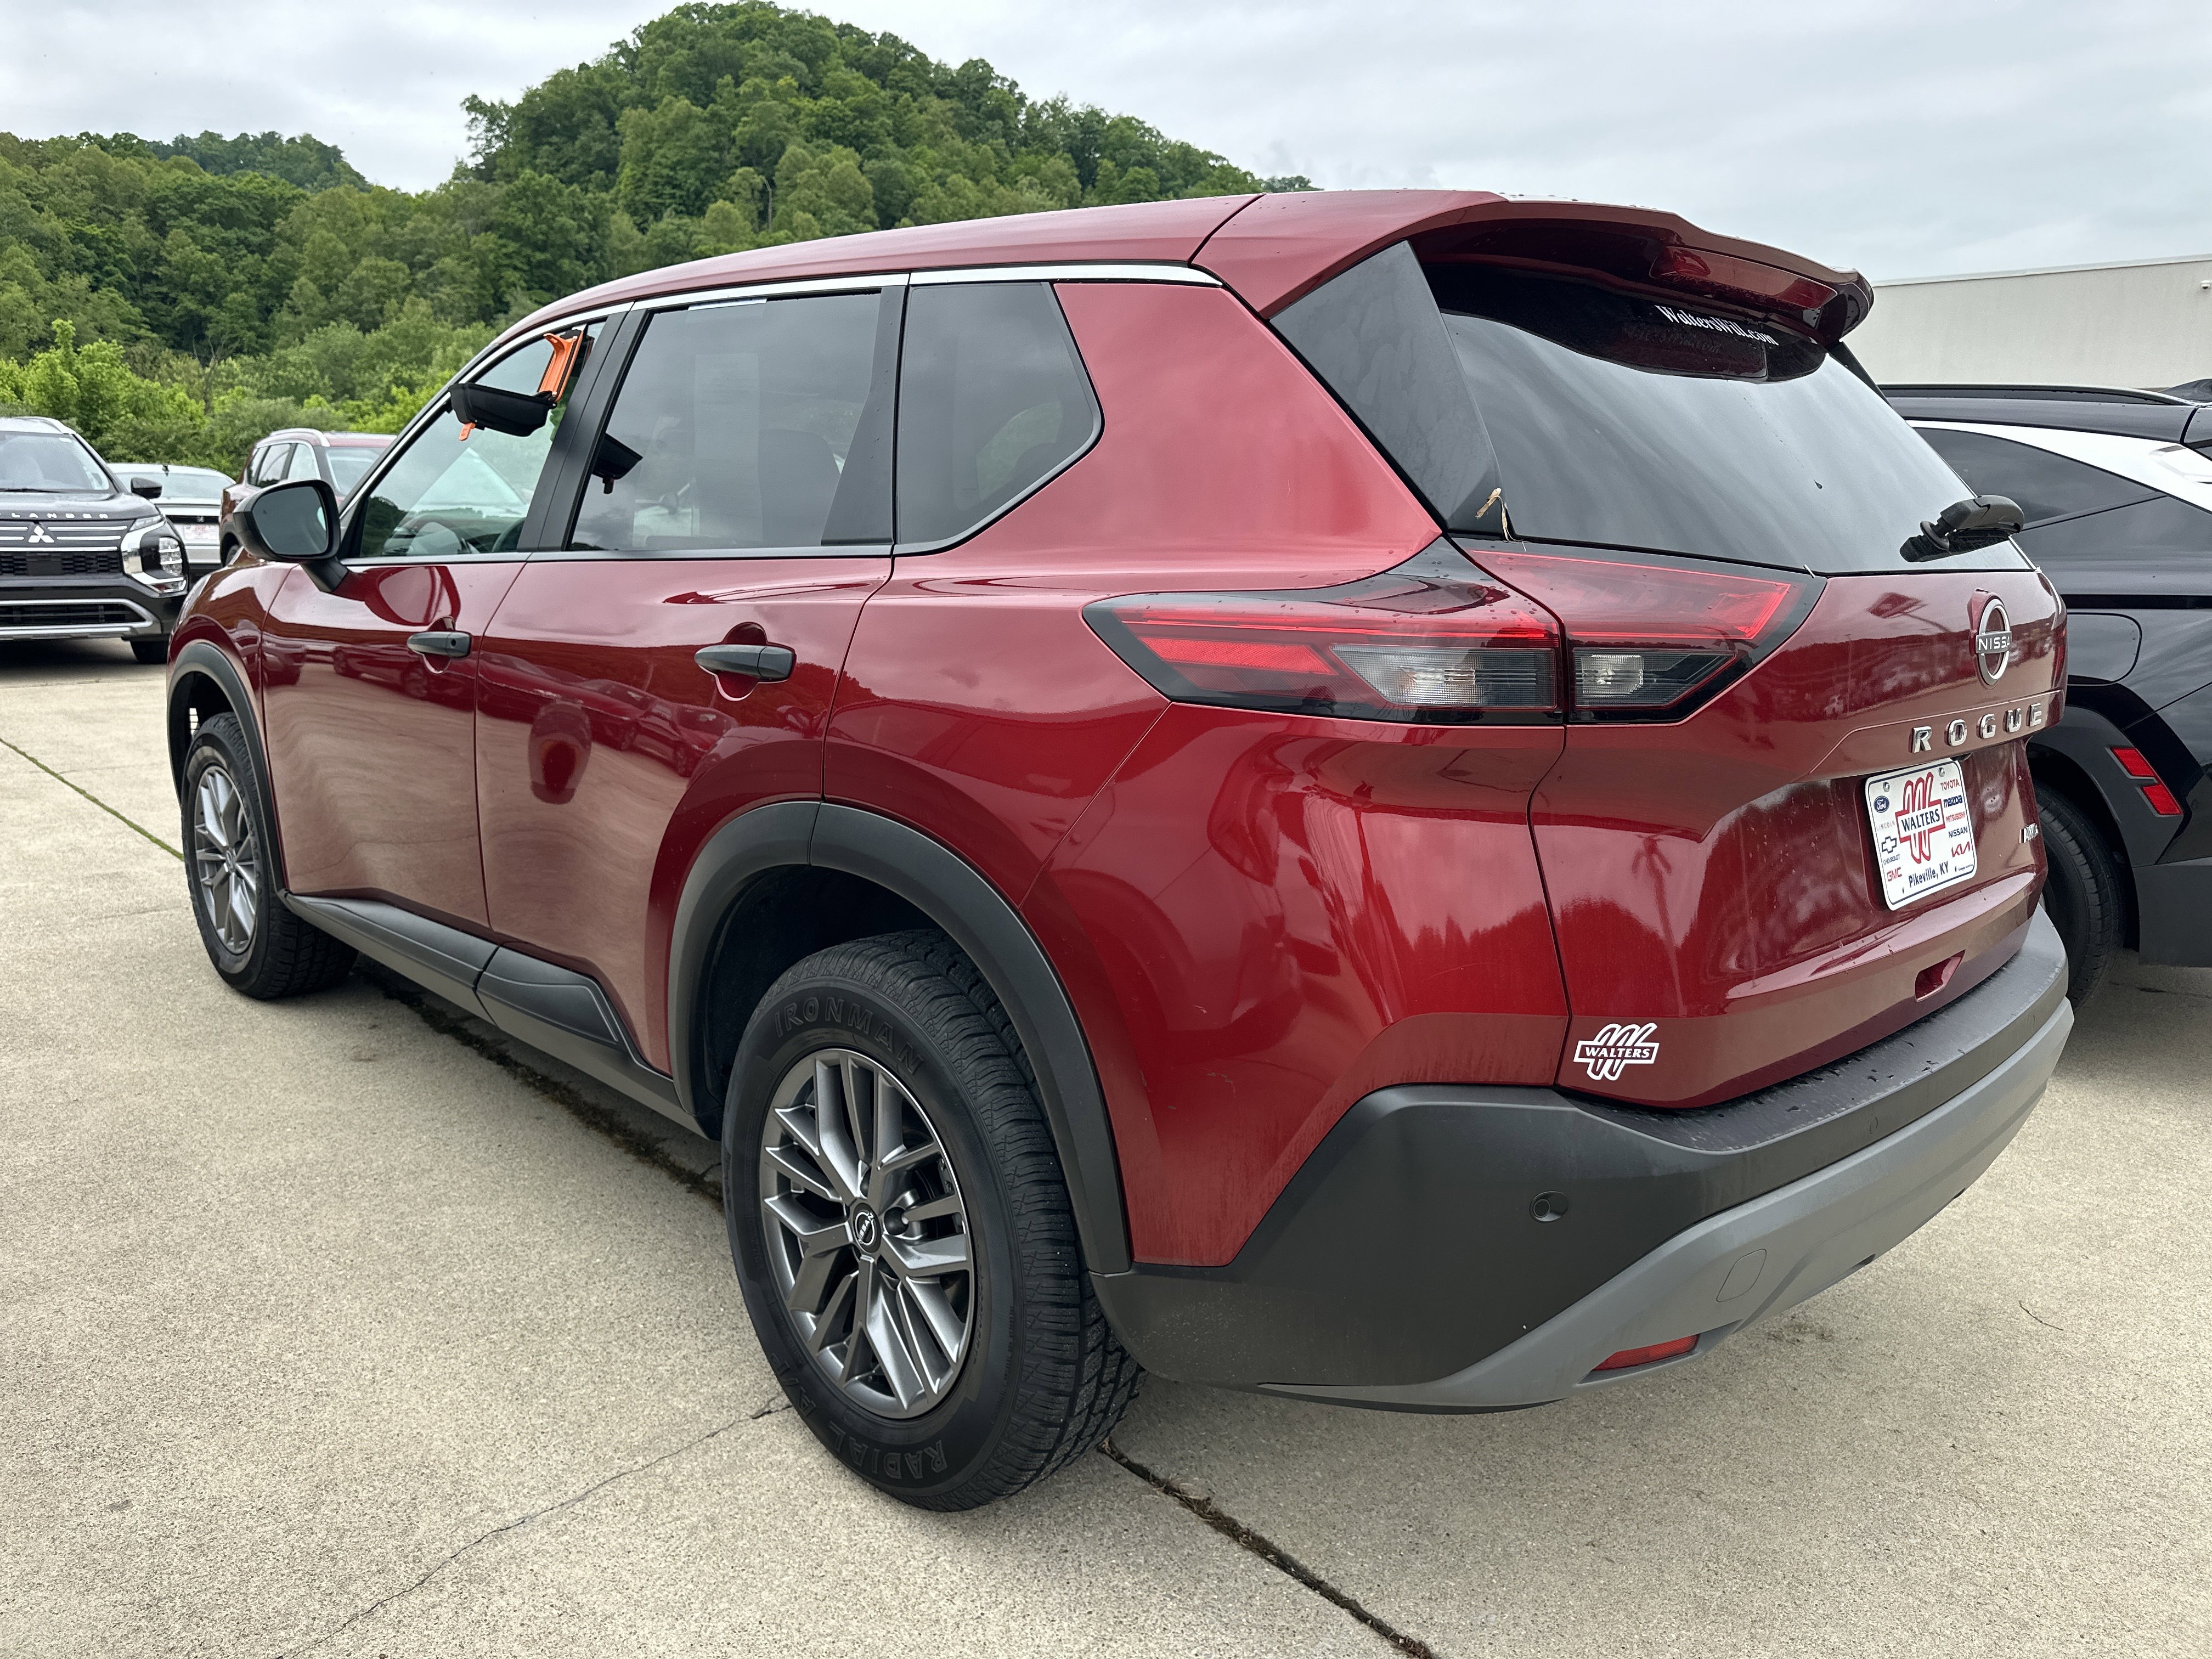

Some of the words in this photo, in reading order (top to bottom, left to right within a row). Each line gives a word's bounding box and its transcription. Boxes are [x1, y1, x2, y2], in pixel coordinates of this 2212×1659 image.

[1655, 305, 1779, 346] WaltersWill.com
[1978, 636, 2011, 651] NISSA
[1911, 703, 2042, 753] ROGUE
[1940, 778, 1960, 791] TOYOTA
[1876, 821, 1895, 832] LINCOLN
[1900, 808, 1940, 832] WALTERS
[1948, 826, 1968, 838] NISSAN
[1883, 854, 1900, 865] CHEVROLET
[1887, 867, 1902, 882] GMC
[1909, 868, 1938, 888] Pikeville,
[1939, 860, 1949, 875] KY
[775, 997, 924, 1076] IRONMAN
[1585, 1047, 1650, 1058] WALTERS
[829, 1421, 948, 1480] RADIAL
